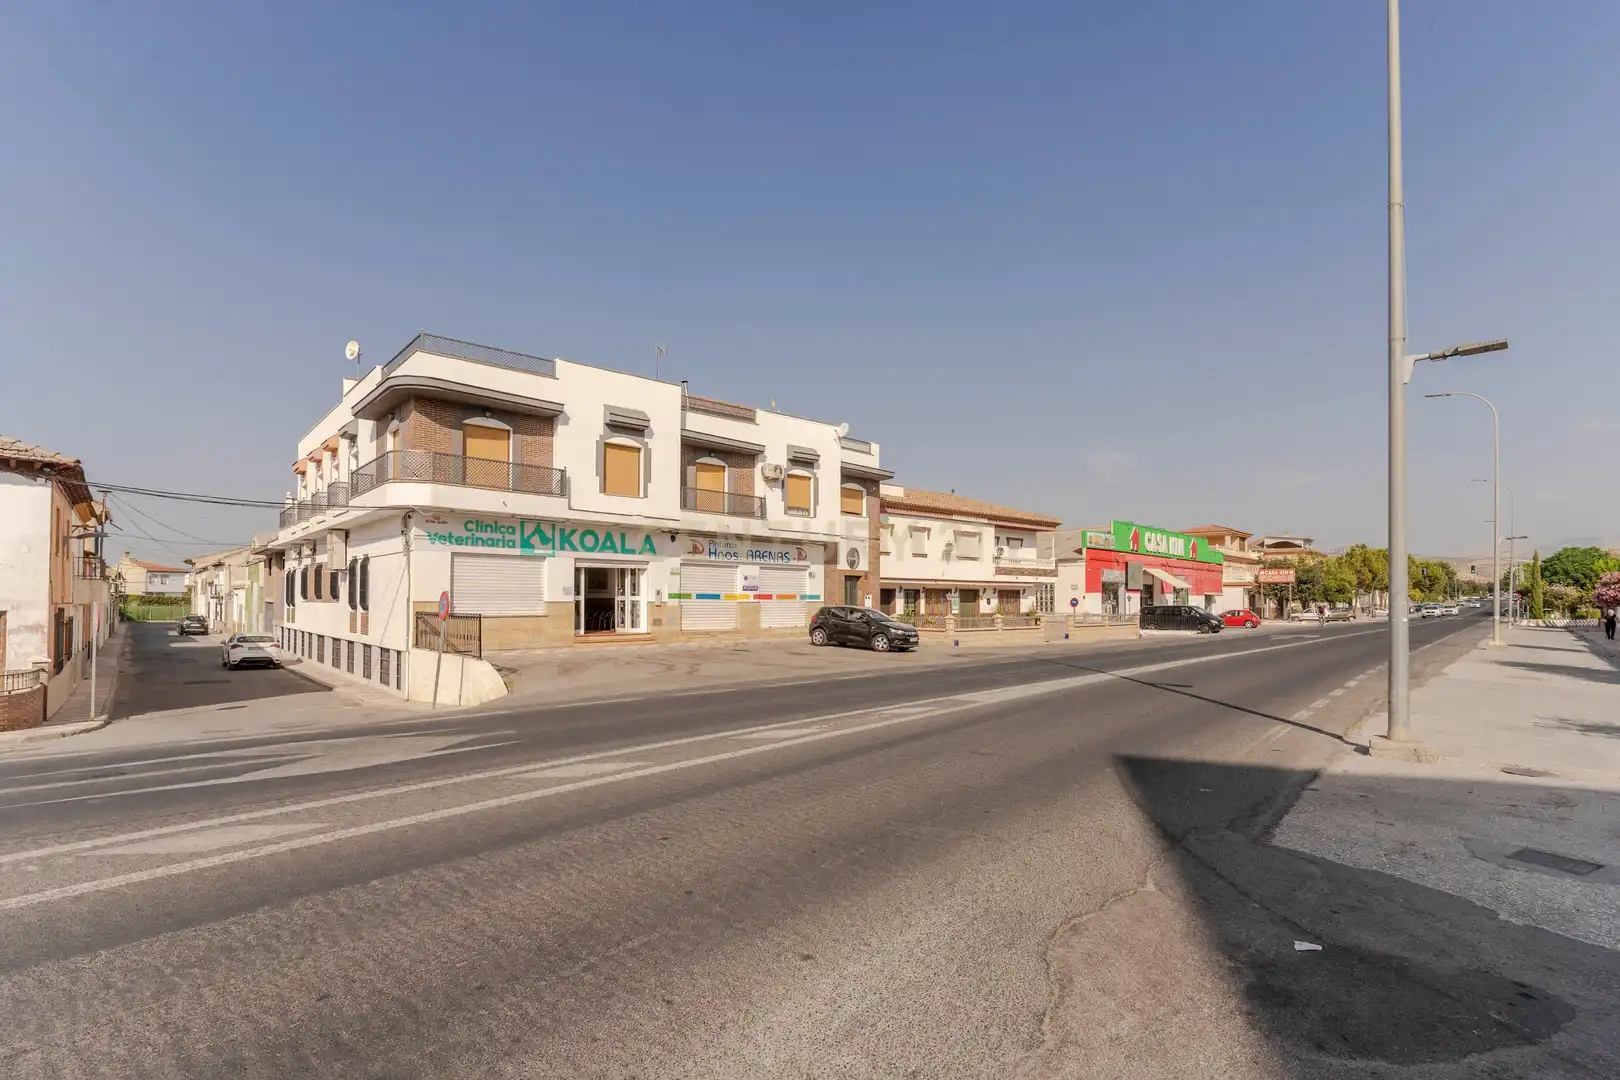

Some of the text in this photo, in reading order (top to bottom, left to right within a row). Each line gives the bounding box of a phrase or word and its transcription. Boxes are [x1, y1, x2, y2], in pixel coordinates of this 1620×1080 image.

[427, 532, 516, 549] Veterinaria
[560, 528, 657, 556] KOALA
[1144, 532, 1168, 552] CASA
[746, 550, 790, 563] ARENAS
